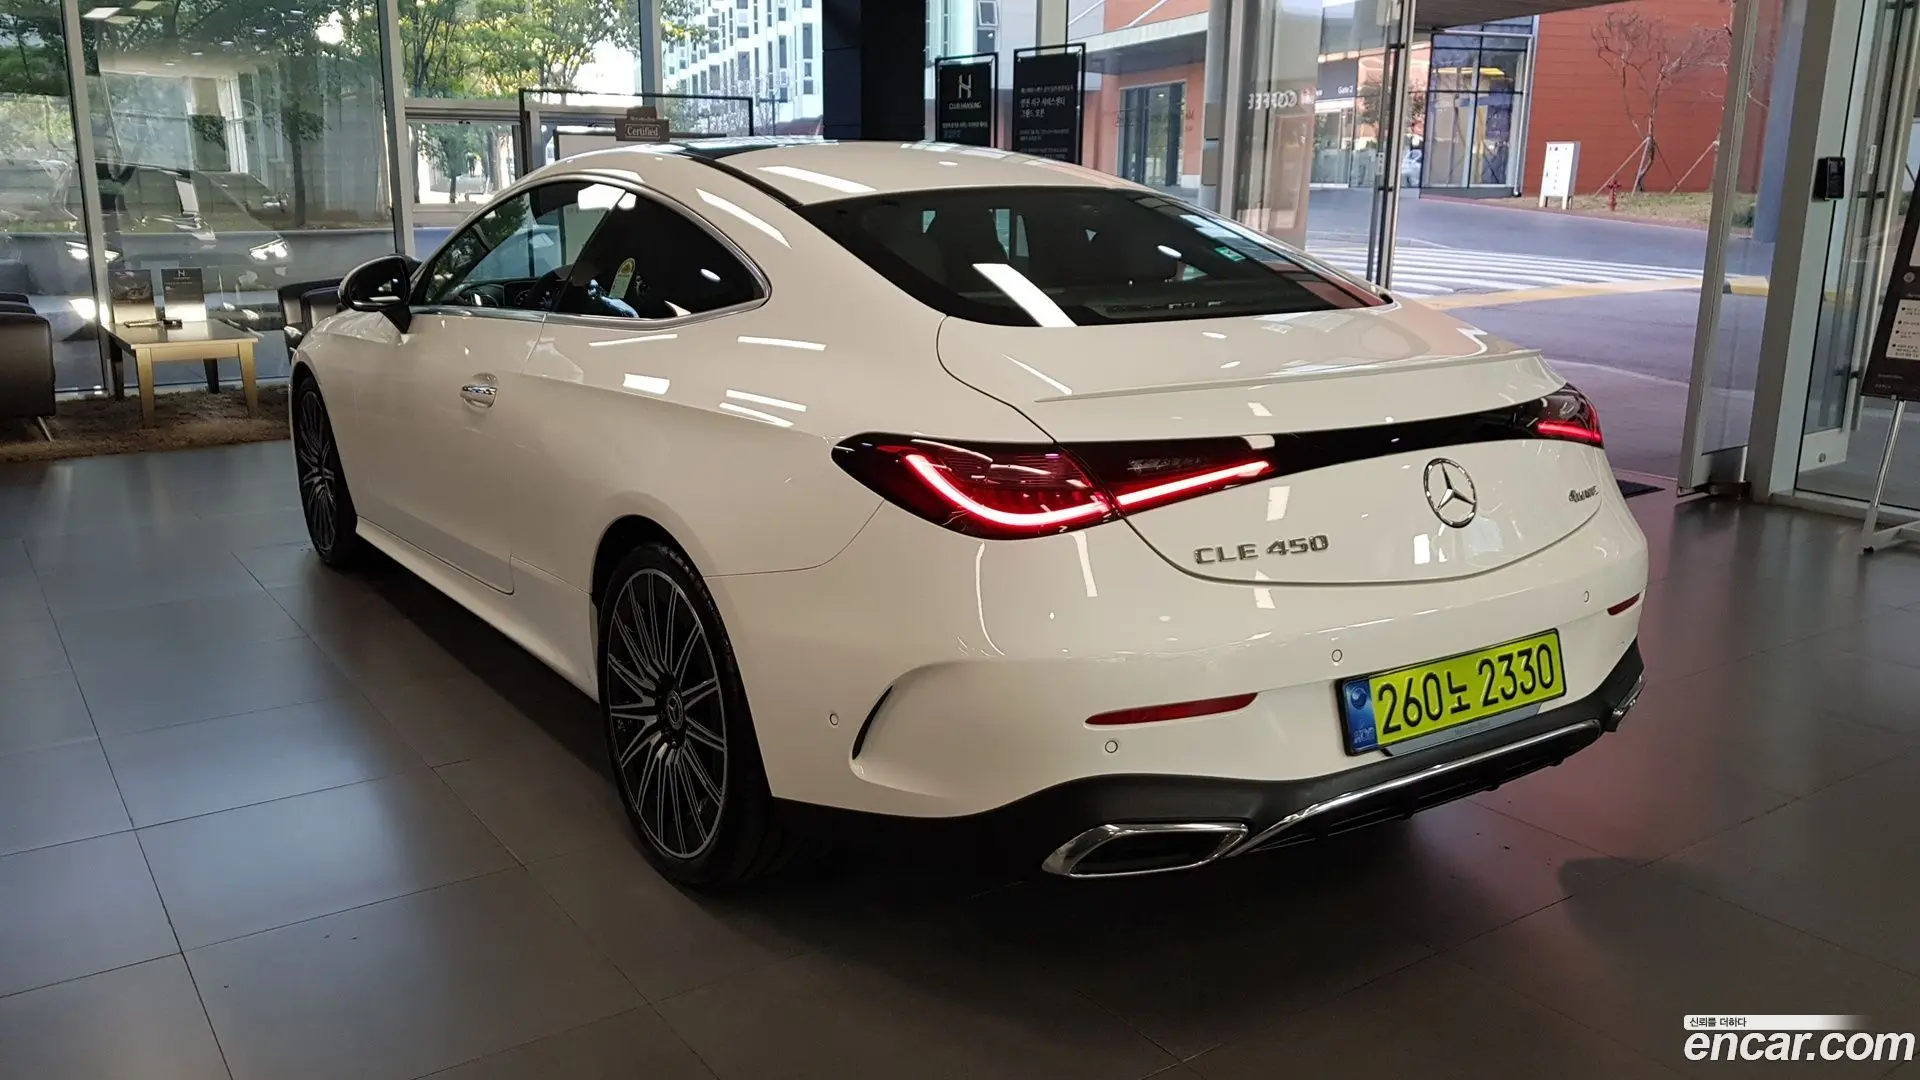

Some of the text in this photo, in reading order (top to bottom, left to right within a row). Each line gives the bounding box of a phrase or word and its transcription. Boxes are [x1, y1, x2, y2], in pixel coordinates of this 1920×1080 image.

[627, 126, 659, 136] Certified
[1193, 534, 1329, 564] CLE 450
[1378, 642, 1555, 735] 260노 2330
